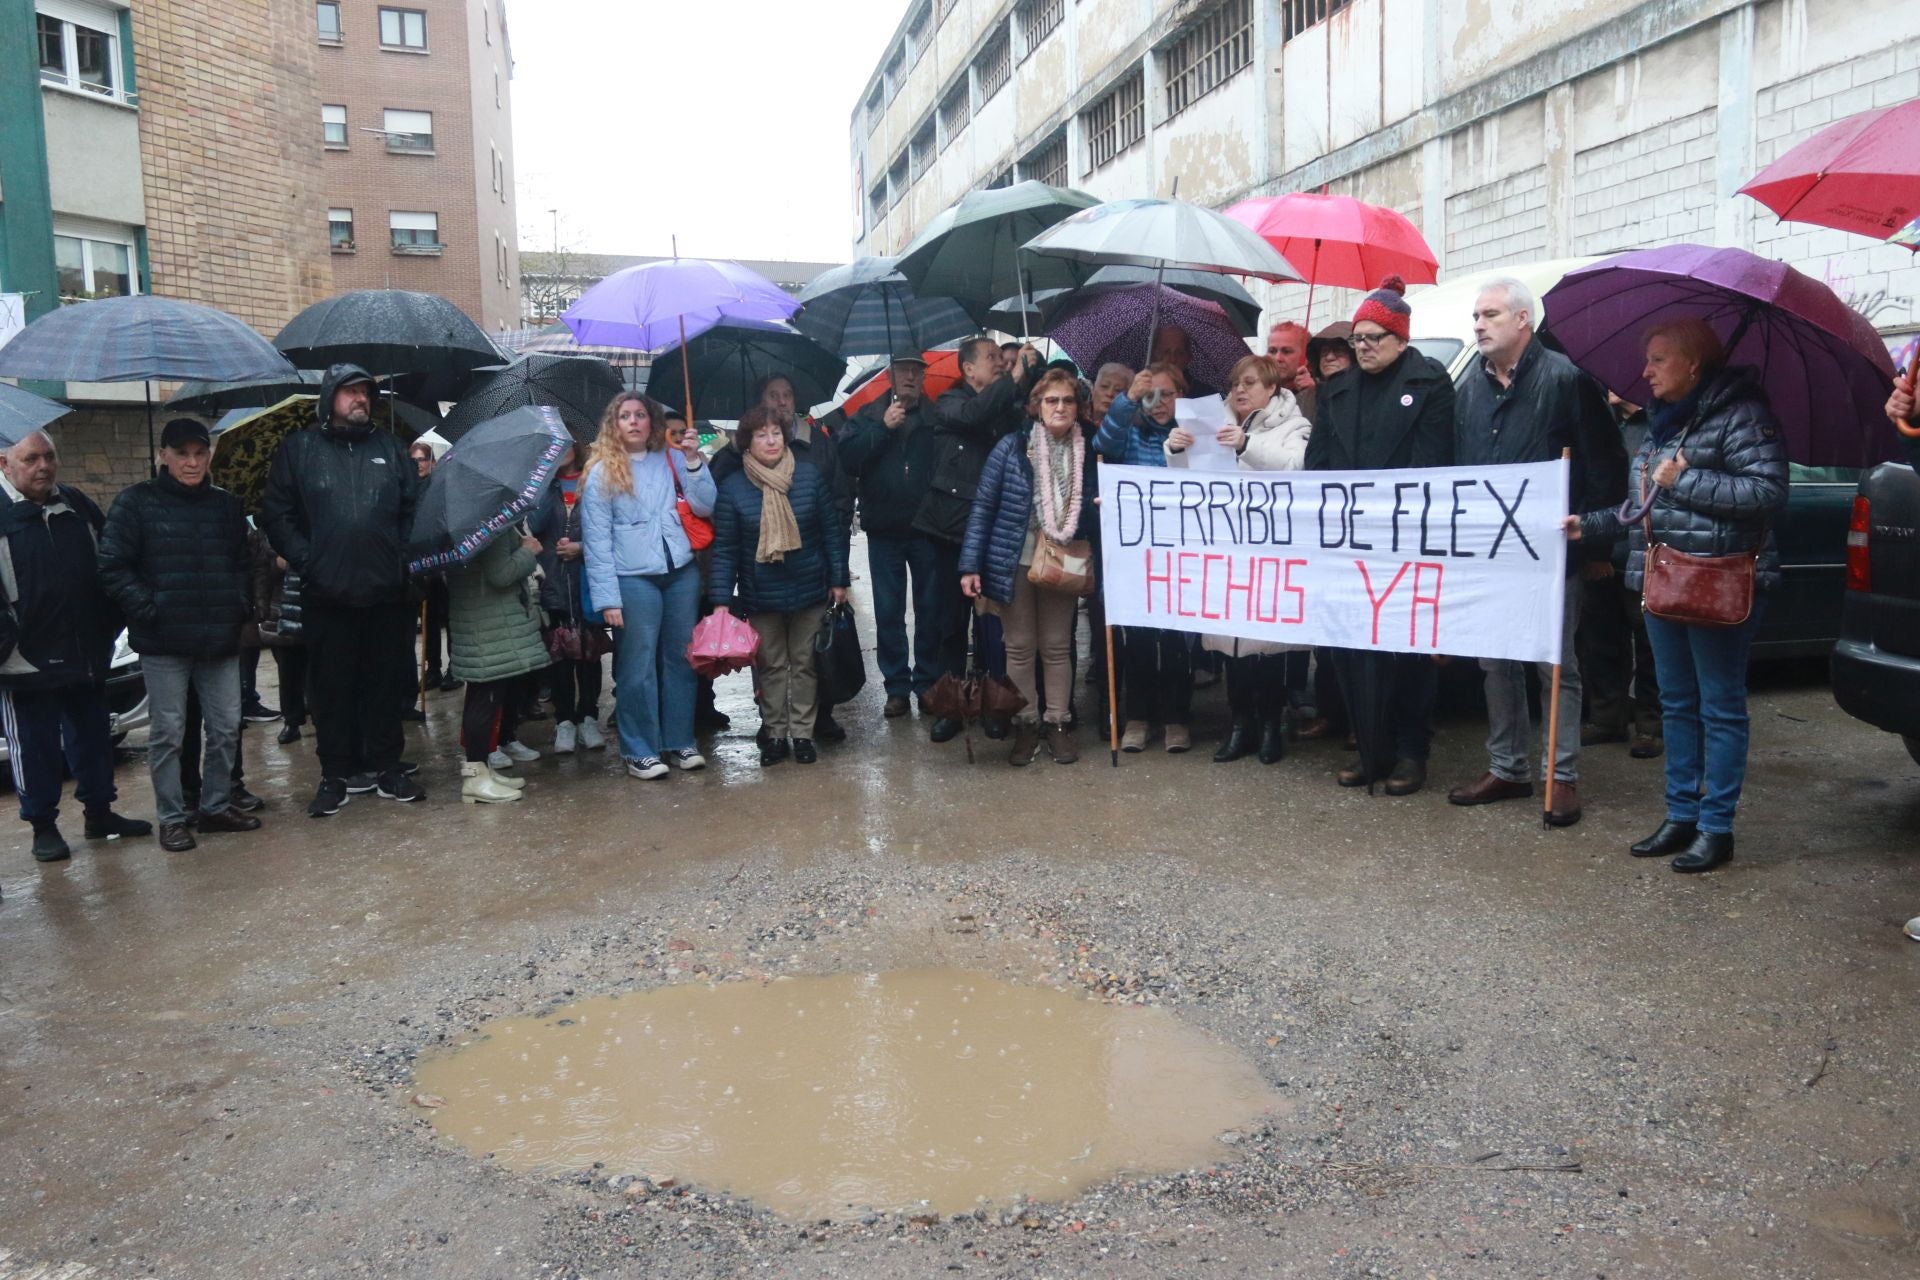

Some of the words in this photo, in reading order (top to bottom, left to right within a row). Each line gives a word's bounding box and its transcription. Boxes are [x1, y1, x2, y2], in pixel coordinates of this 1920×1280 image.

[1117, 478, 1293, 547] DERRIBO
[1319, 482, 1375, 551] DE
[1392, 478, 1540, 561] FLEX
[1145, 549, 1308, 624] HECHOS
[1355, 559, 1444, 648] YA
